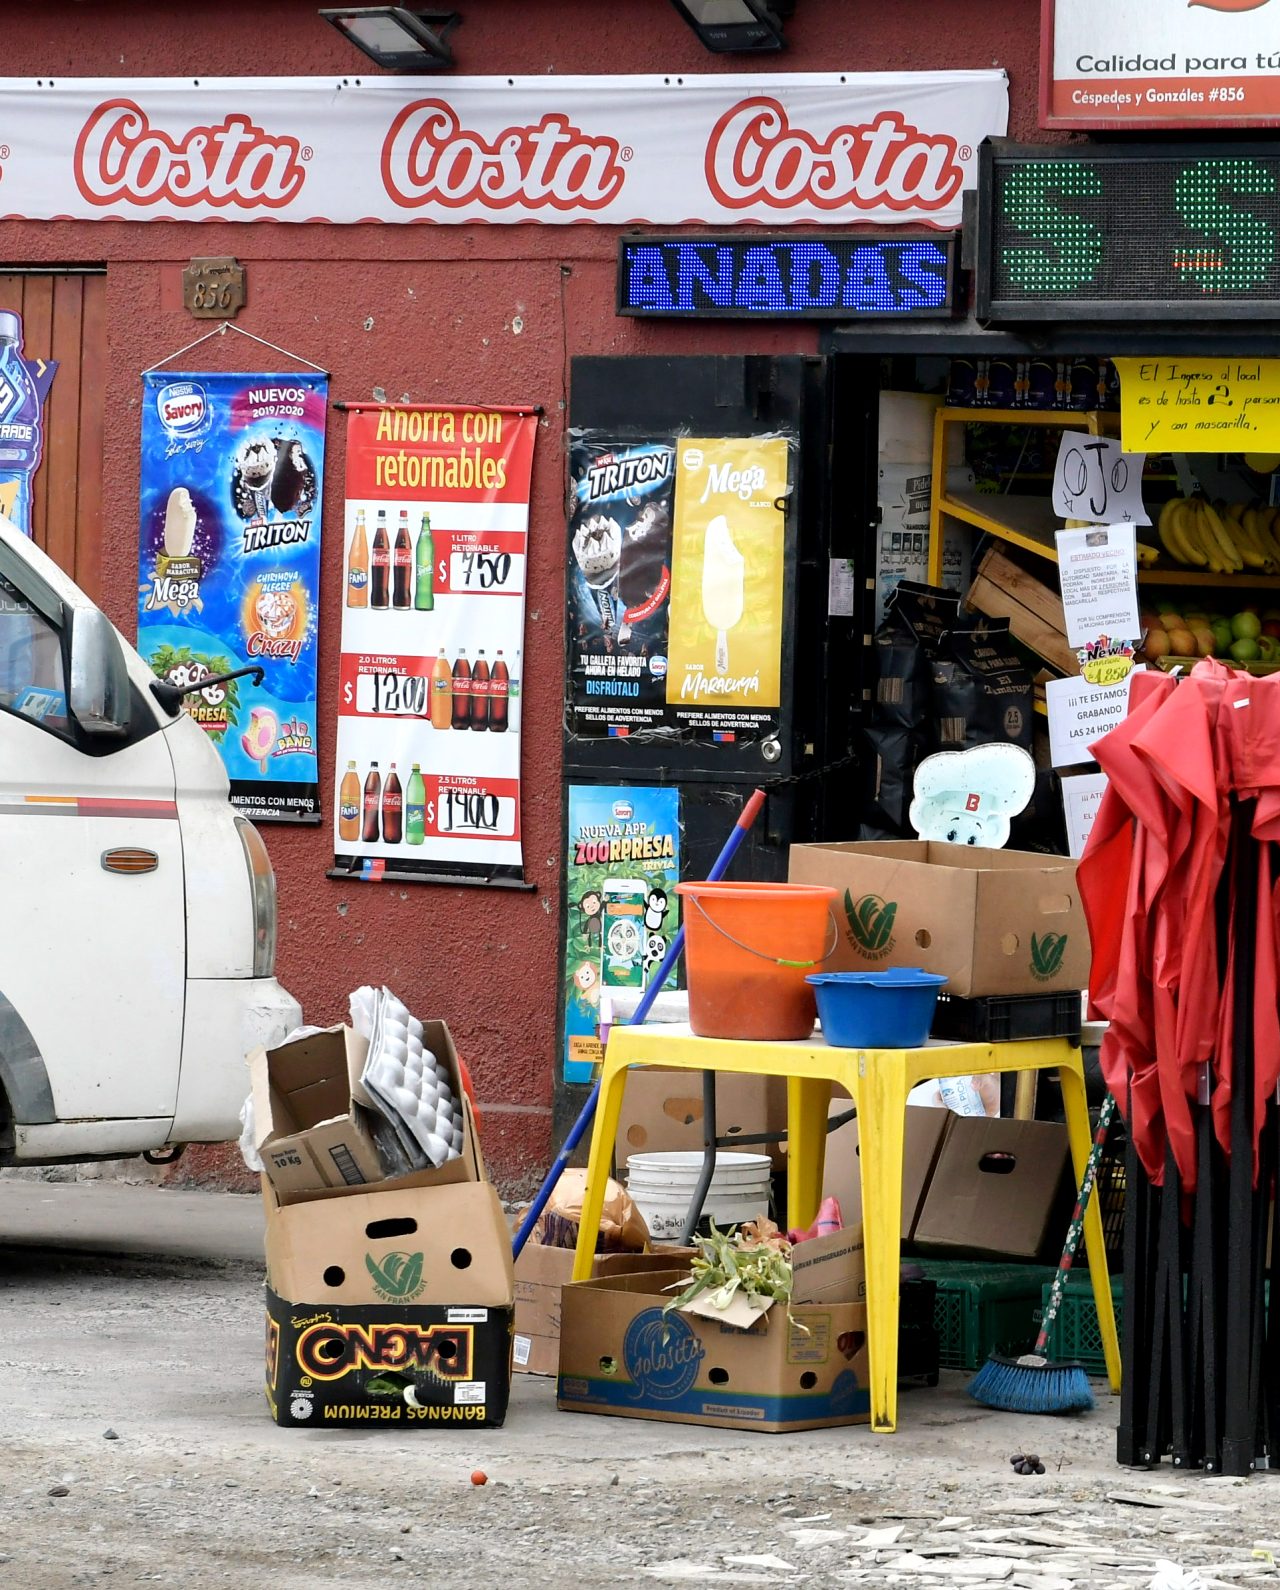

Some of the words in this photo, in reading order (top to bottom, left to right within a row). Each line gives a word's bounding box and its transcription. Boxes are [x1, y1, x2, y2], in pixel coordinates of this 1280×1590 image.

[1075, 53, 1178, 73] Calidad
[1185, 56, 1248, 75] para
[1072, 88, 1132, 106] Céspedes
[1146, 87, 1205, 103] Gonzáles
[1208, 87, 1245, 103] #856
[74, 98, 305, 208] Costa
[381, 98, 625, 209] Costa
[705, 96, 963, 211] Costa
[194, 282, 231, 308] 856
[1140, 364, 1159, 381] El
[1167, 364, 1213, 389] Ingreso
[1221, 365, 1230, 381] al
[1237, 364, 1260, 381] local
[248, 388, 306, 404] NUEVOS
[1156, 390, 1168, 406] de
[1176, 388, 1201, 406] hasta
[164, 402, 203, 421] Savory
[252, 405, 305, 418] 2019/2020
[376, 408, 456, 443] Ahorra
[462, 411, 503, 444] con
[1145, 420, 1160, 440] y
[376, 447, 507, 489] retornables
[588, 453, 670, 499] TRITON
[700, 462, 765, 504] Mega
[1063, 442, 1129, 516] OJO
[243, 521, 309, 553] TRITON
[452, 544, 500, 552] RETORNABLE
[461, 552, 512, 588] 750
[146, 578, 200, 611] Mega
[261, 582, 292, 593] ALEGRE
[247, 632, 304, 664] Crazy
[371, 657, 397, 665] LITROS
[590, 655, 616, 666] GALLETA
[617, 655, 647, 667] FAVORITA
[358, 666, 407, 675] RETORNABLE
[585, 665, 606, 676] AHORA
[617, 666, 641, 677] HELADO
[372, 671, 426, 713] 1200
[585, 678, 640, 697] DISFRÚTALO
[1078, 696, 1089, 705] TE
[1090, 688, 1128, 704] ESTAMOS
[574, 706, 600, 714] PREFIERE
[600, 707, 631, 715] ALIMENTOS
[644, 708, 664, 716] MENOS
[585, 714, 607, 722] SELLOS
[615, 714, 653, 723] ADVERTENCIA
[676, 711, 703, 720] PREFIERE
[703, 712, 736, 721] ALIMENTOS
[750, 713, 771, 722] MENOS
[1077, 705, 1122, 721] GRABANDO
[688, 719, 710, 728] SELLOS
[719, 720, 760, 729] ADVERTENCIA
[1069, 728, 1084, 739] LAS
[1086, 726, 1096, 736] 24
[451, 777, 477, 785] LITROS
[438, 786, 487, 796] RETORNABLE
[267, 796, 285, 807] CON
[286, 797, 315, 809] MENOS
[580, 823, 622, 840] NUEVA
[624, 822, 647, 836] APP
[574, 835, 675, 866] ZOORPRESA
[641, 860, 675, 872] TRIVIA
[297, 1323, 474, 1381] BAGNO
[324, 1404, 401, 1419] PREMIUM
[406, 1406, 486, 1421] BANANAS
